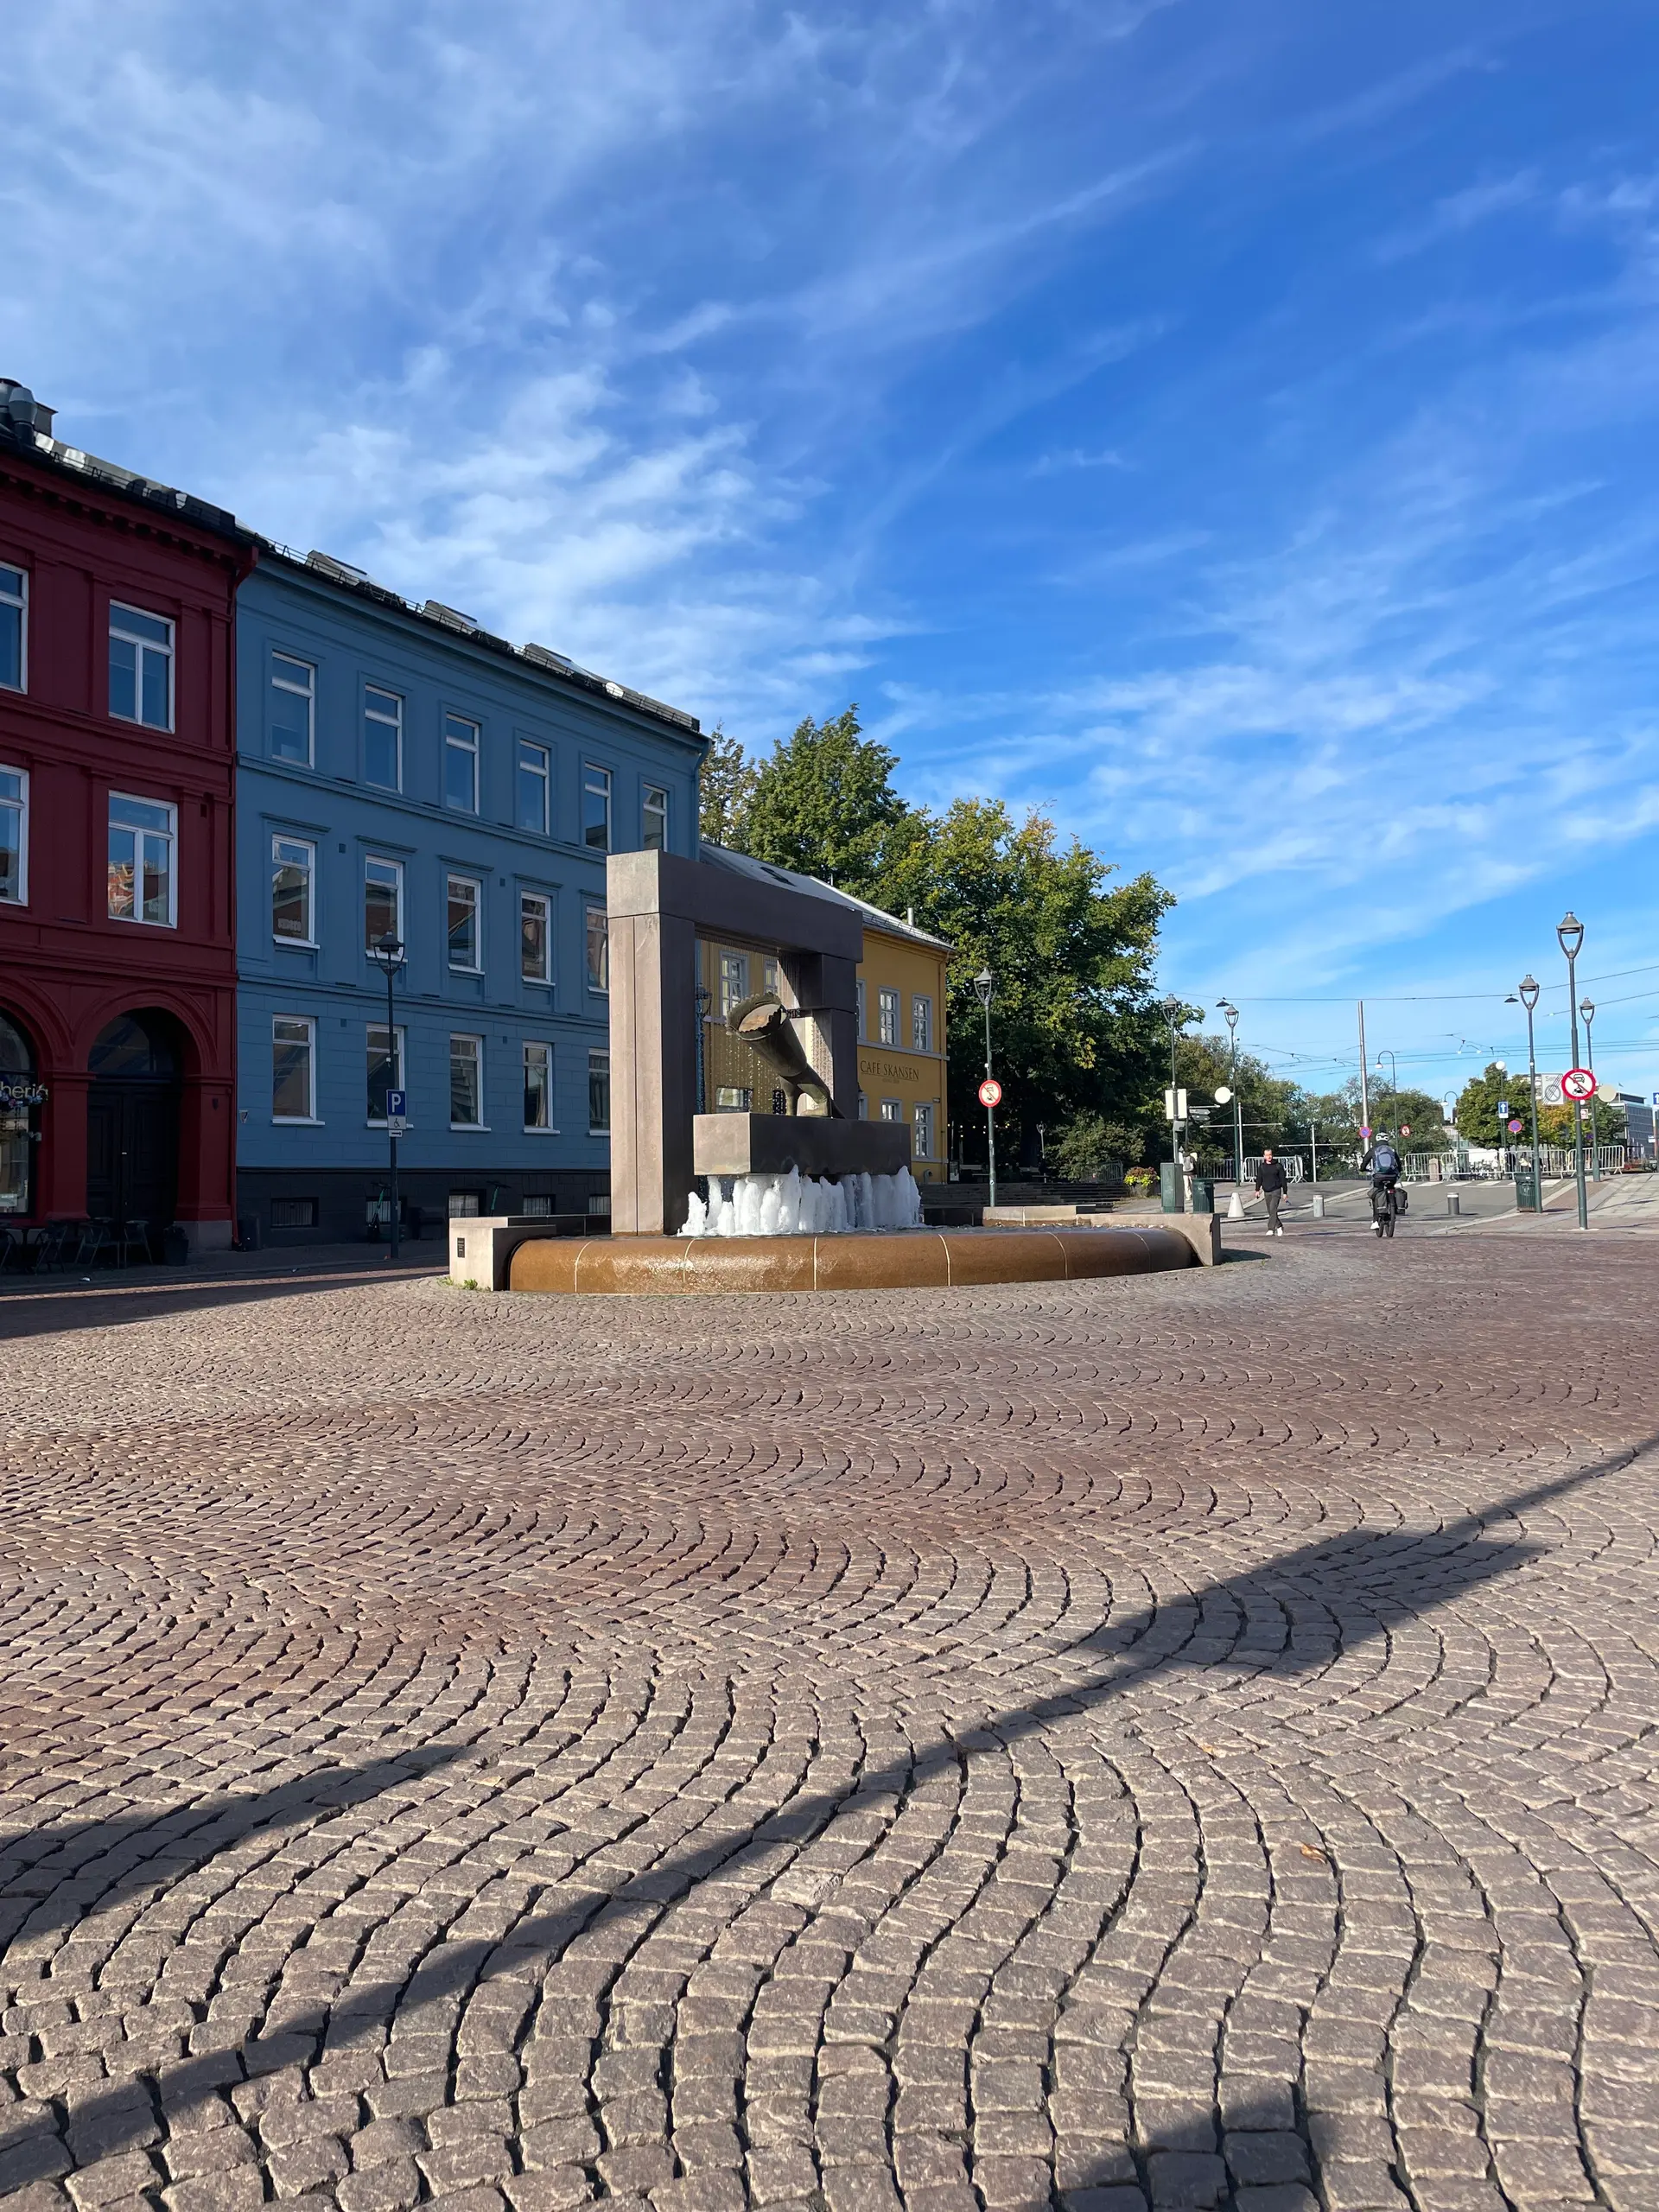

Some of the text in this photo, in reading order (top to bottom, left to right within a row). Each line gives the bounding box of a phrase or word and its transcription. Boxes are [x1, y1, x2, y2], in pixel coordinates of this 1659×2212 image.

[860, 1060, 919, 1080] CAFÉ SKANSEN
[391, 1093, 402, 1113] P
